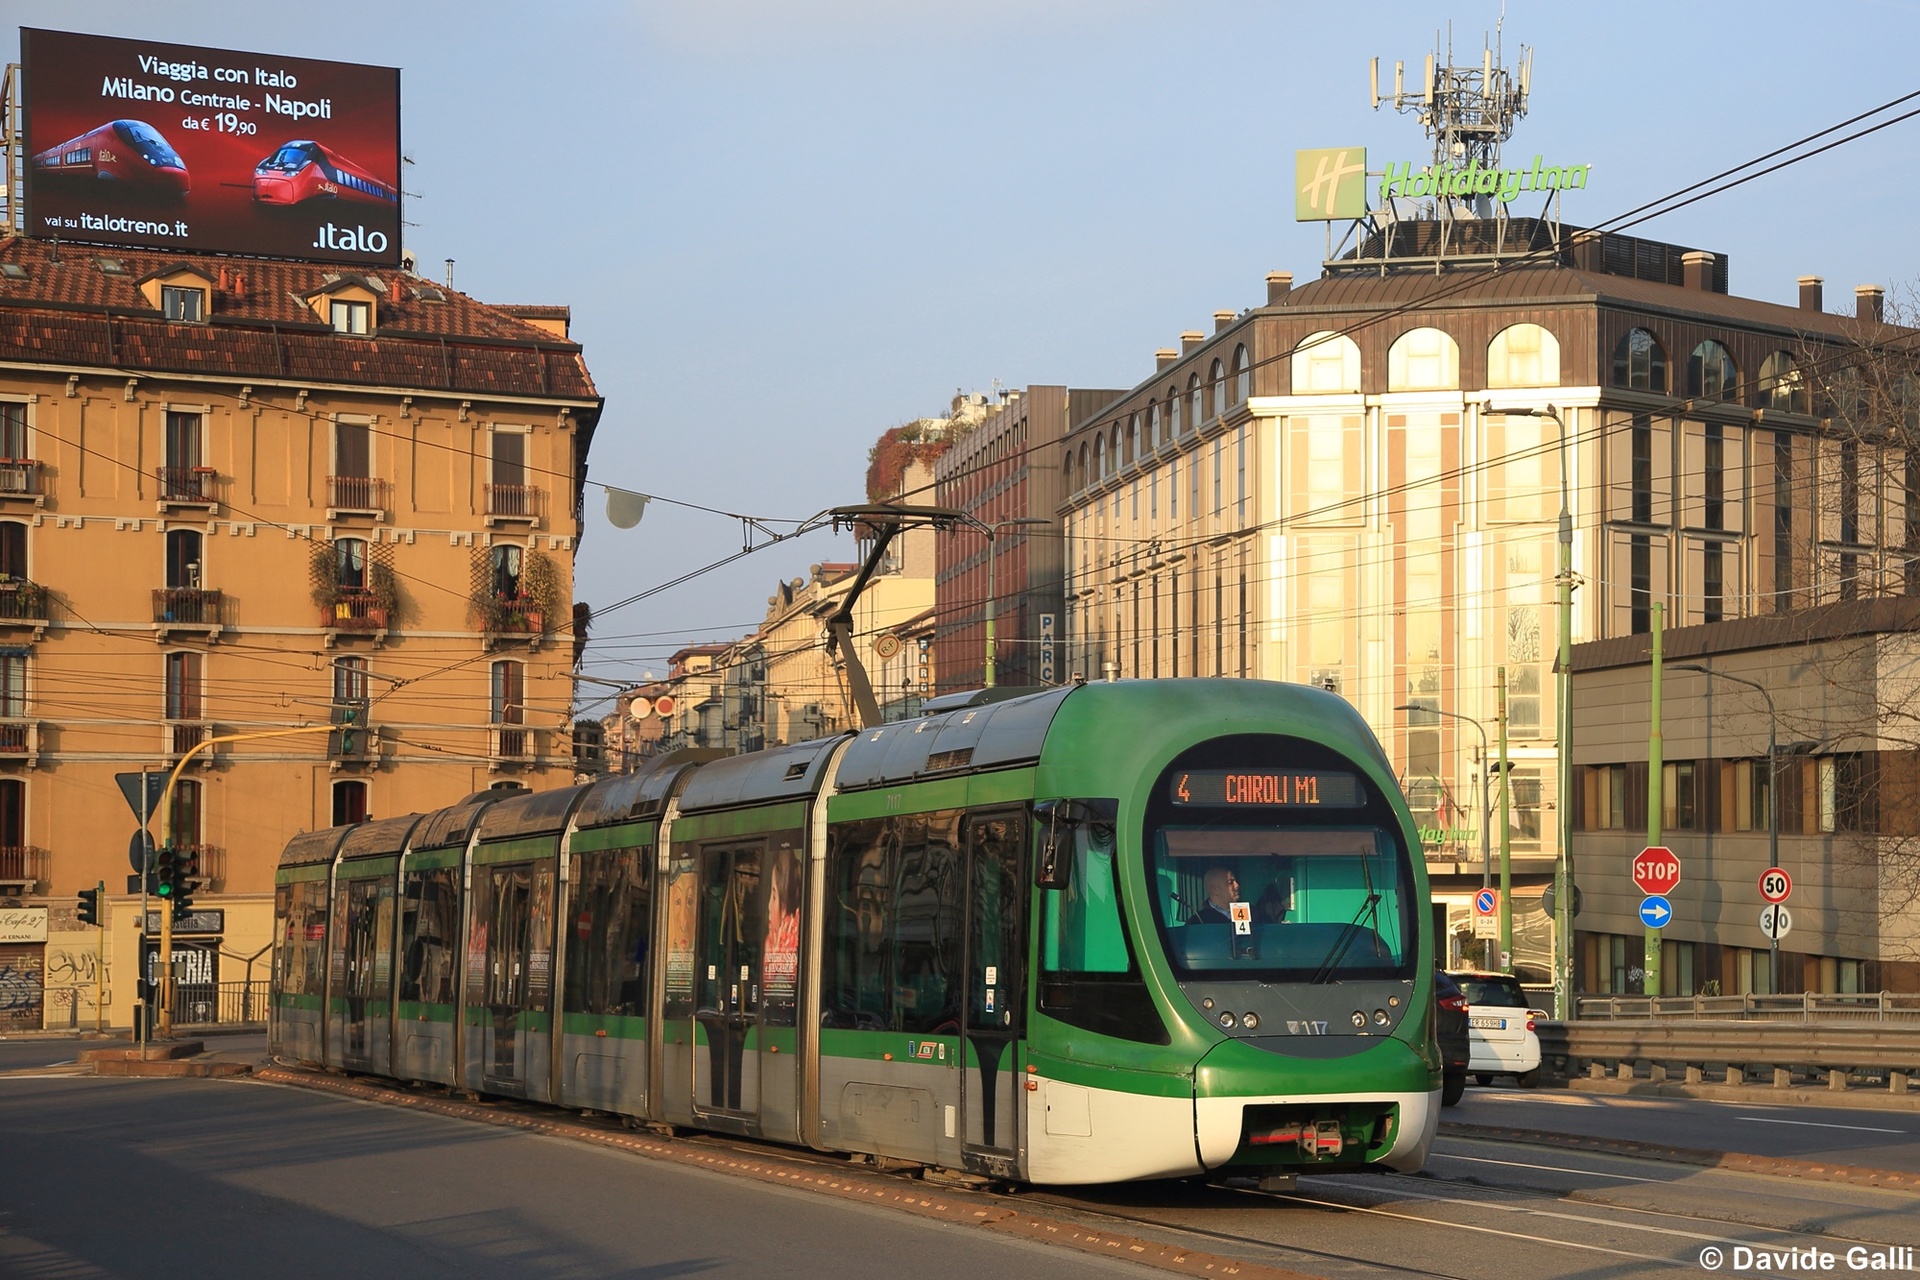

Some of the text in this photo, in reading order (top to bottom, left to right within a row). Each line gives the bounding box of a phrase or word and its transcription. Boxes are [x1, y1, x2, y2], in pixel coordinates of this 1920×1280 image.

[138, 54, 298, 89] Viaggia con Italo
[101, 76, 175, 103] Milano
[180, 90, 251, 111] Centrale
[264, 93, 332, 122] Napoli
[182, 113, 257, 136] da € 19,90
[1379, 154, 1589, 203] Holiday Inn
[44, 212, 189, 238] vai su italotreno.it
[1177, 774, 1320, 804] 4 CAIROLI M1
[1450, 823, 1478, 841] Inn
[1635, 861, 1678, 881] STOP
[1765, 877, 1786, 894] 50
[27, 915, 46, 929] 27
[1237, 908, 1245, 920] 4
[1763, 913, 1789, 930] 30
[1239, 921, 1246, 933] 4
